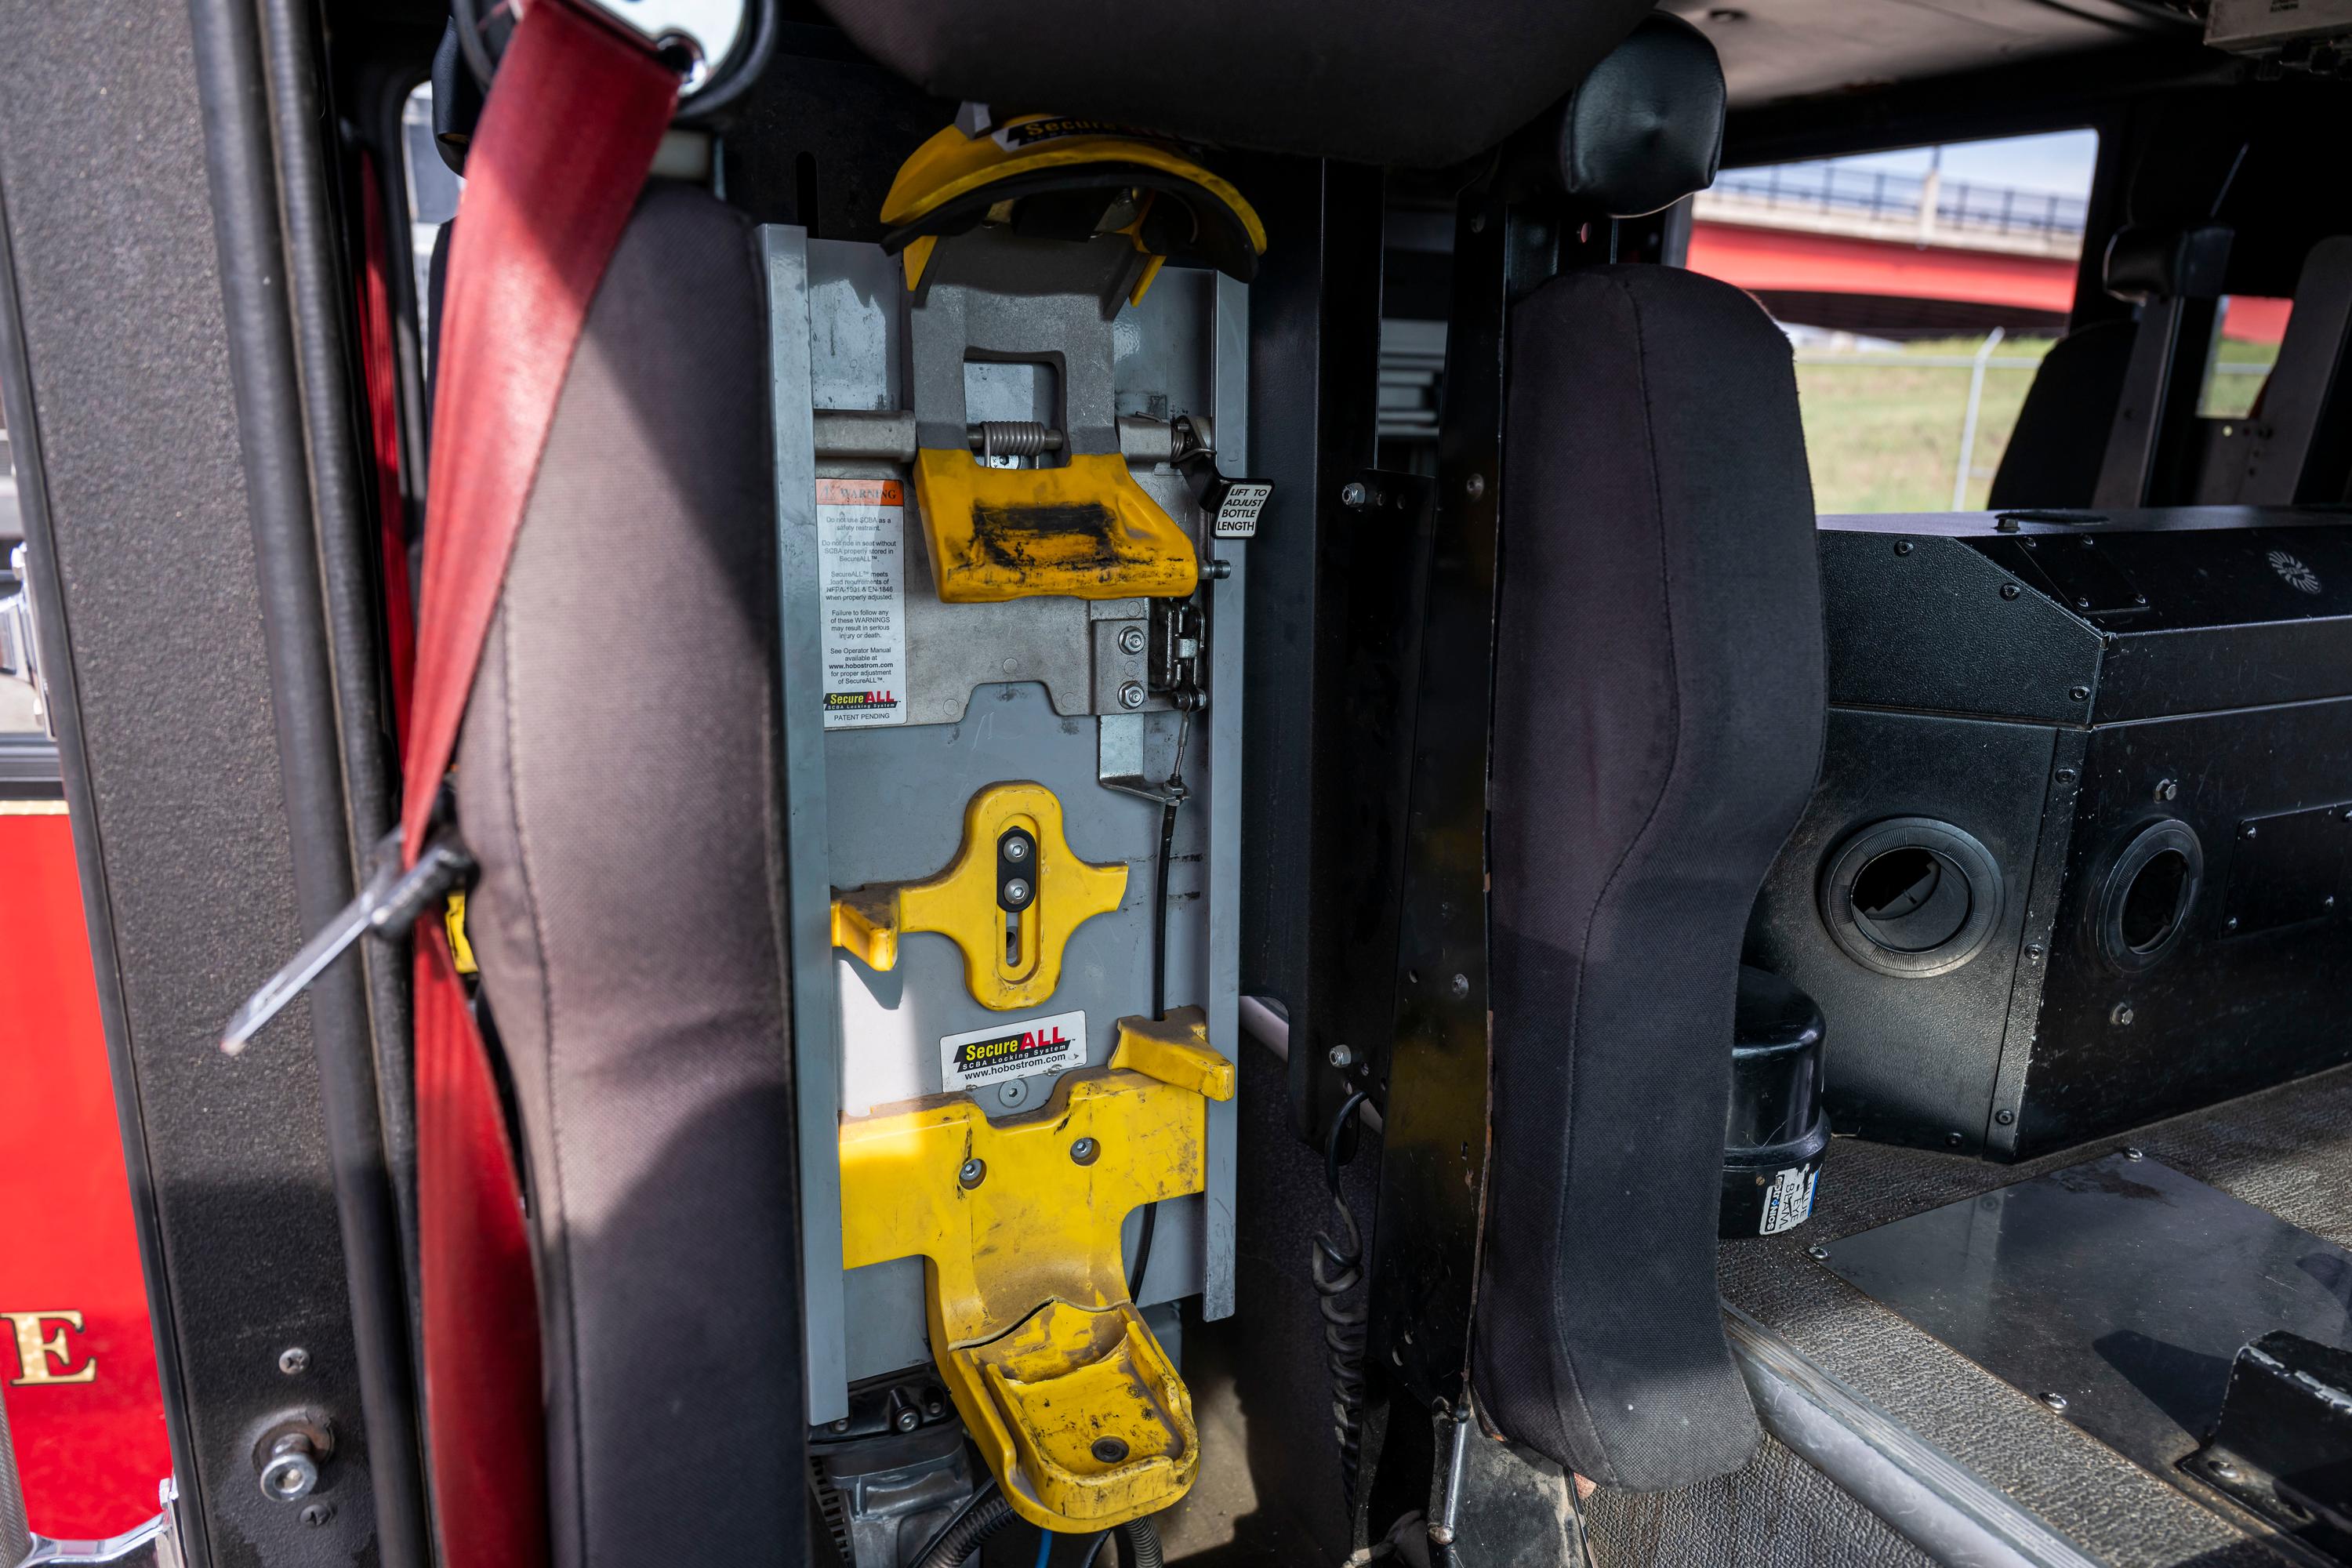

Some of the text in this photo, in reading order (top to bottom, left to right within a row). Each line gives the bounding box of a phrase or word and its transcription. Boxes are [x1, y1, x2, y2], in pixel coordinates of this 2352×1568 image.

[840, 488, 896, 499] WARNING
[1224, 499, 1264, 507] ADJUST
[1217, 521, 1254, 531] LENGTH
[962, 1044, 1065, 1070] SCBA Locking System
[965, 1054, 1065, 1080] www.hobostrom.com
[1791, 1198, 1801, 1222] EYE
